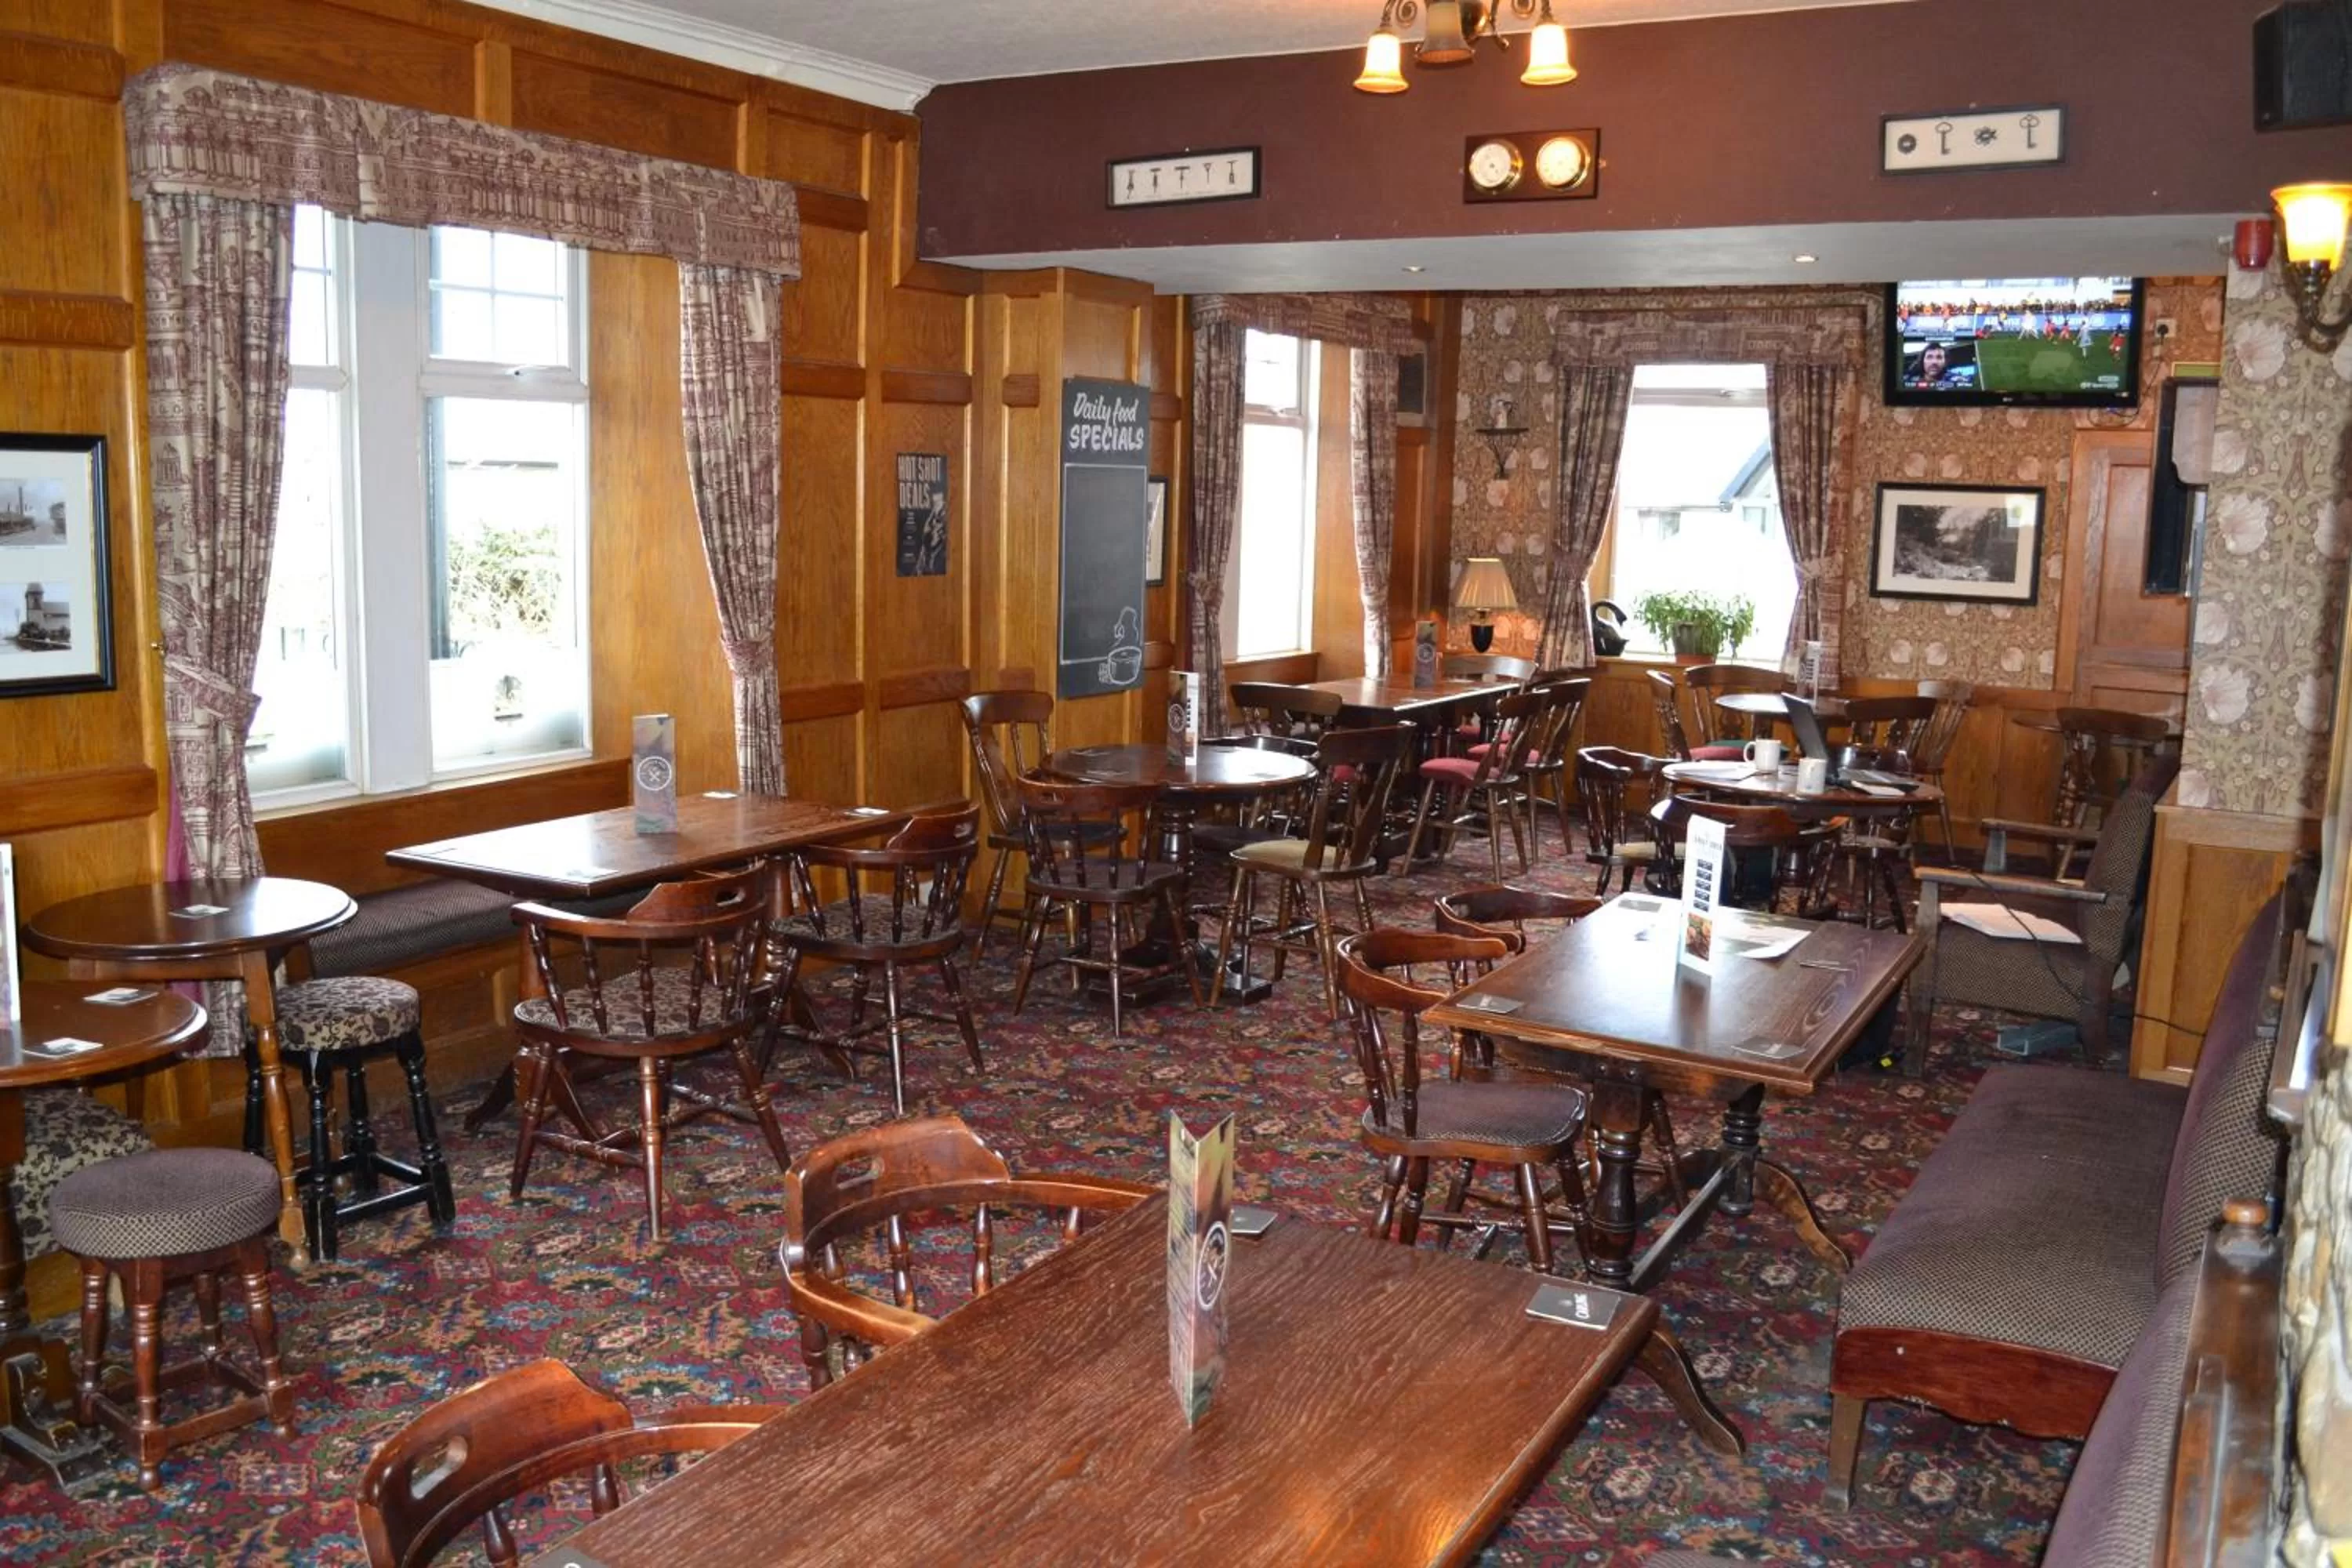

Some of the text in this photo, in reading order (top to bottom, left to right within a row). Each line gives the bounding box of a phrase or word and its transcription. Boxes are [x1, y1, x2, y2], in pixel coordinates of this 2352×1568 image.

[1073, 392, 1139, 429] Daily food
[1069, 424, 1144, 450] SPECIALS
[898, 456, 942, 482] HOT SHOT
[899, 482, 930, 508] DEALS
